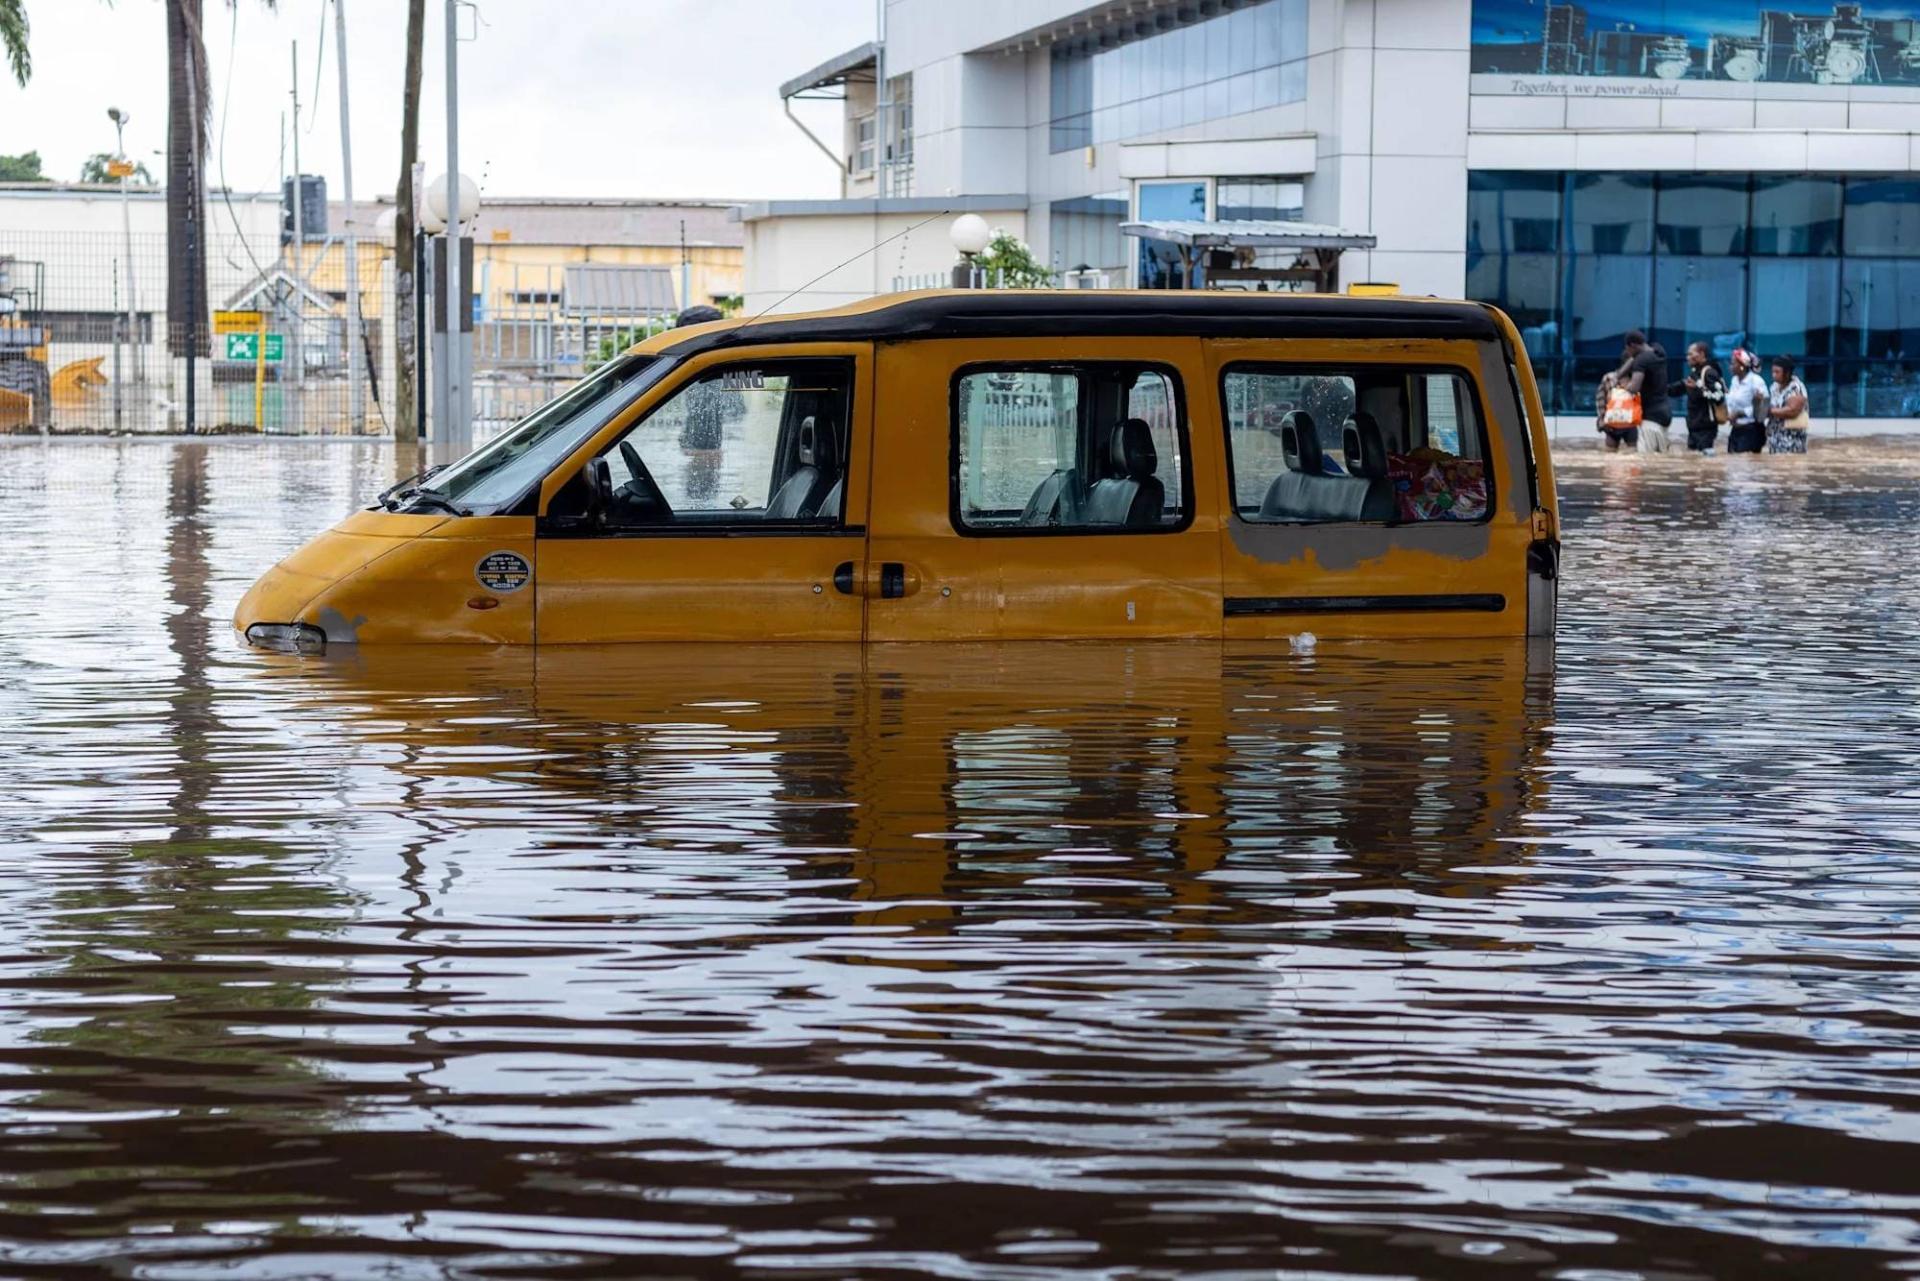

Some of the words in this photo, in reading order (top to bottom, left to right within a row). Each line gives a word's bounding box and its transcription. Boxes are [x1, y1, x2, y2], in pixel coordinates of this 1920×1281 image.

[1511, 80, 1568, 95] Together,
[1575, 85, 1593, 93] we
[1595, 85, 1634, 97] power
[1639, 84, 1681, 96] ahead.
[722, 370, 764, 389] KING
